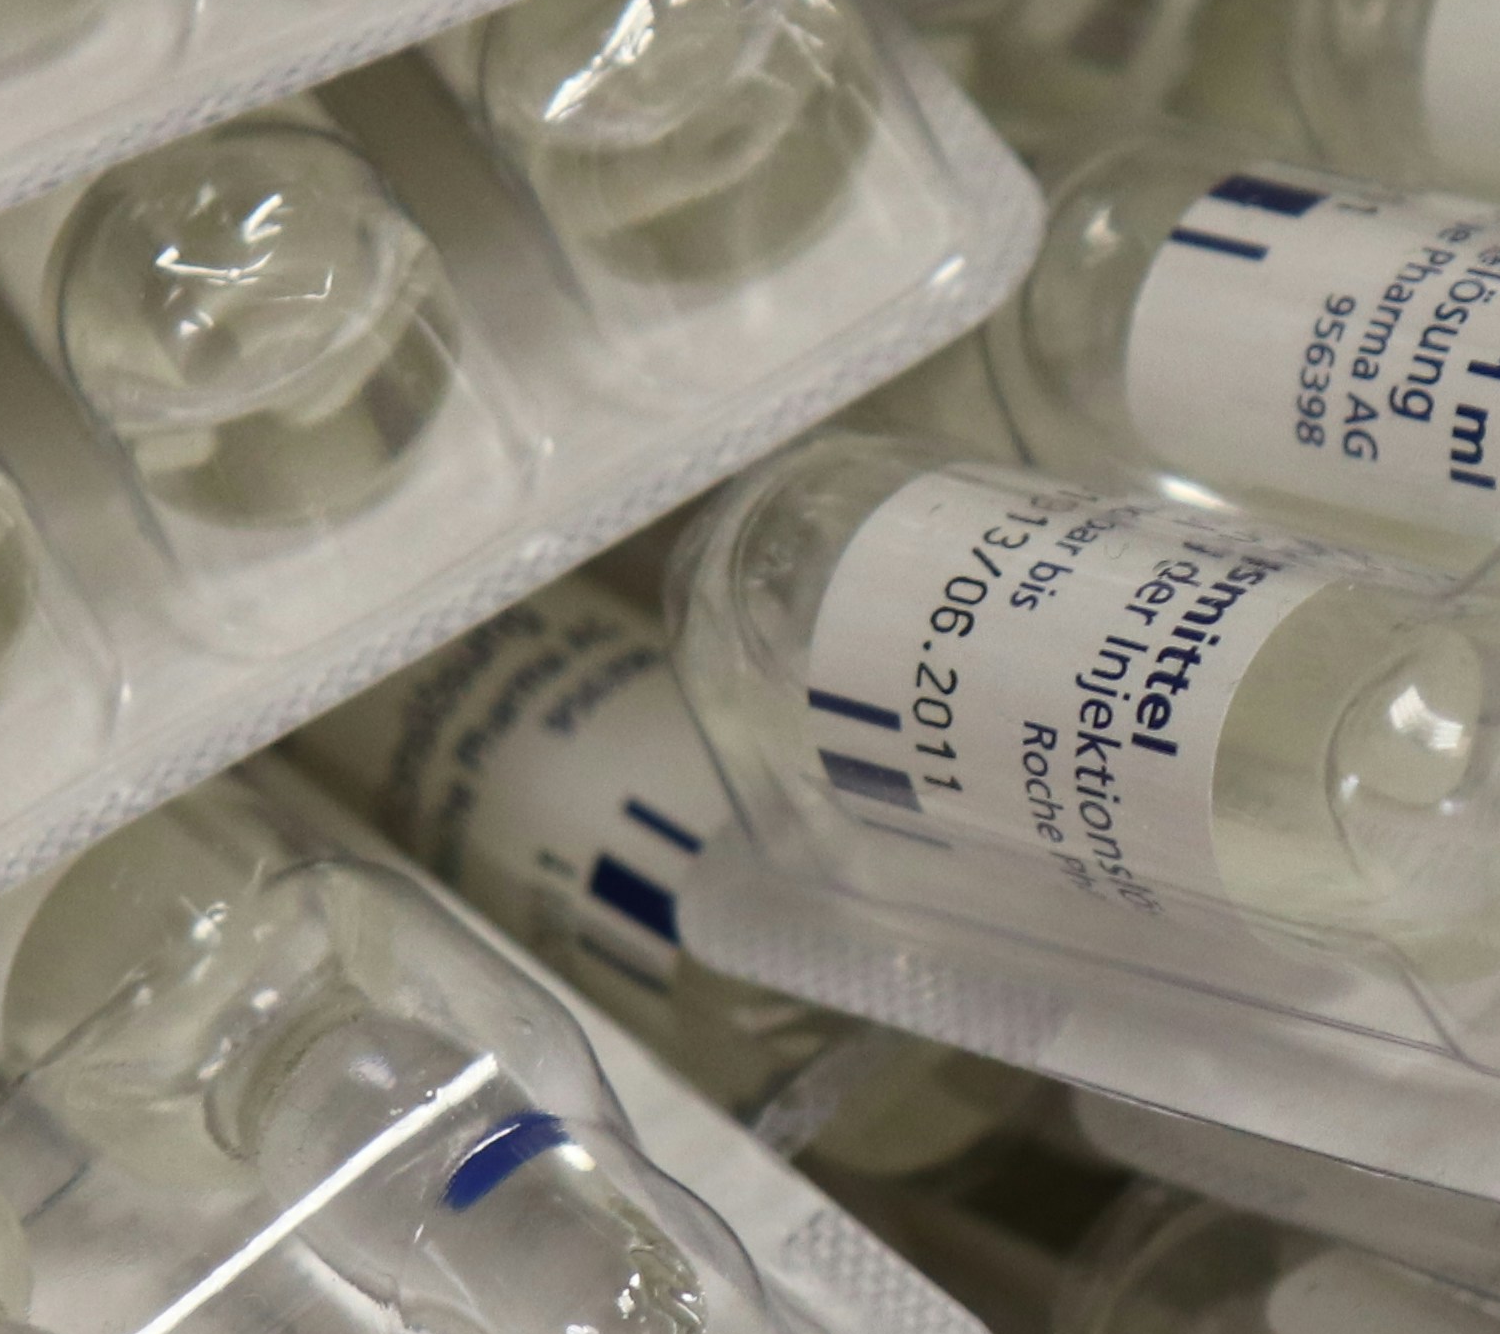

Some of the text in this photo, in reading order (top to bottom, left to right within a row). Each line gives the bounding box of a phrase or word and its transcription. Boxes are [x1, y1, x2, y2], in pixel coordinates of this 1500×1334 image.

[1349, 246, 1459, 385] Pharma
[1293, 292, 1359, 451] 956398
[1340, 392, 1382, 464] AG
[1449, 402, 1498, 492] ml
[1009, 558, 1075, 614] bis
[1124, 556, 1202, 630] der
[1020, 718, 1066, 846] Roche
